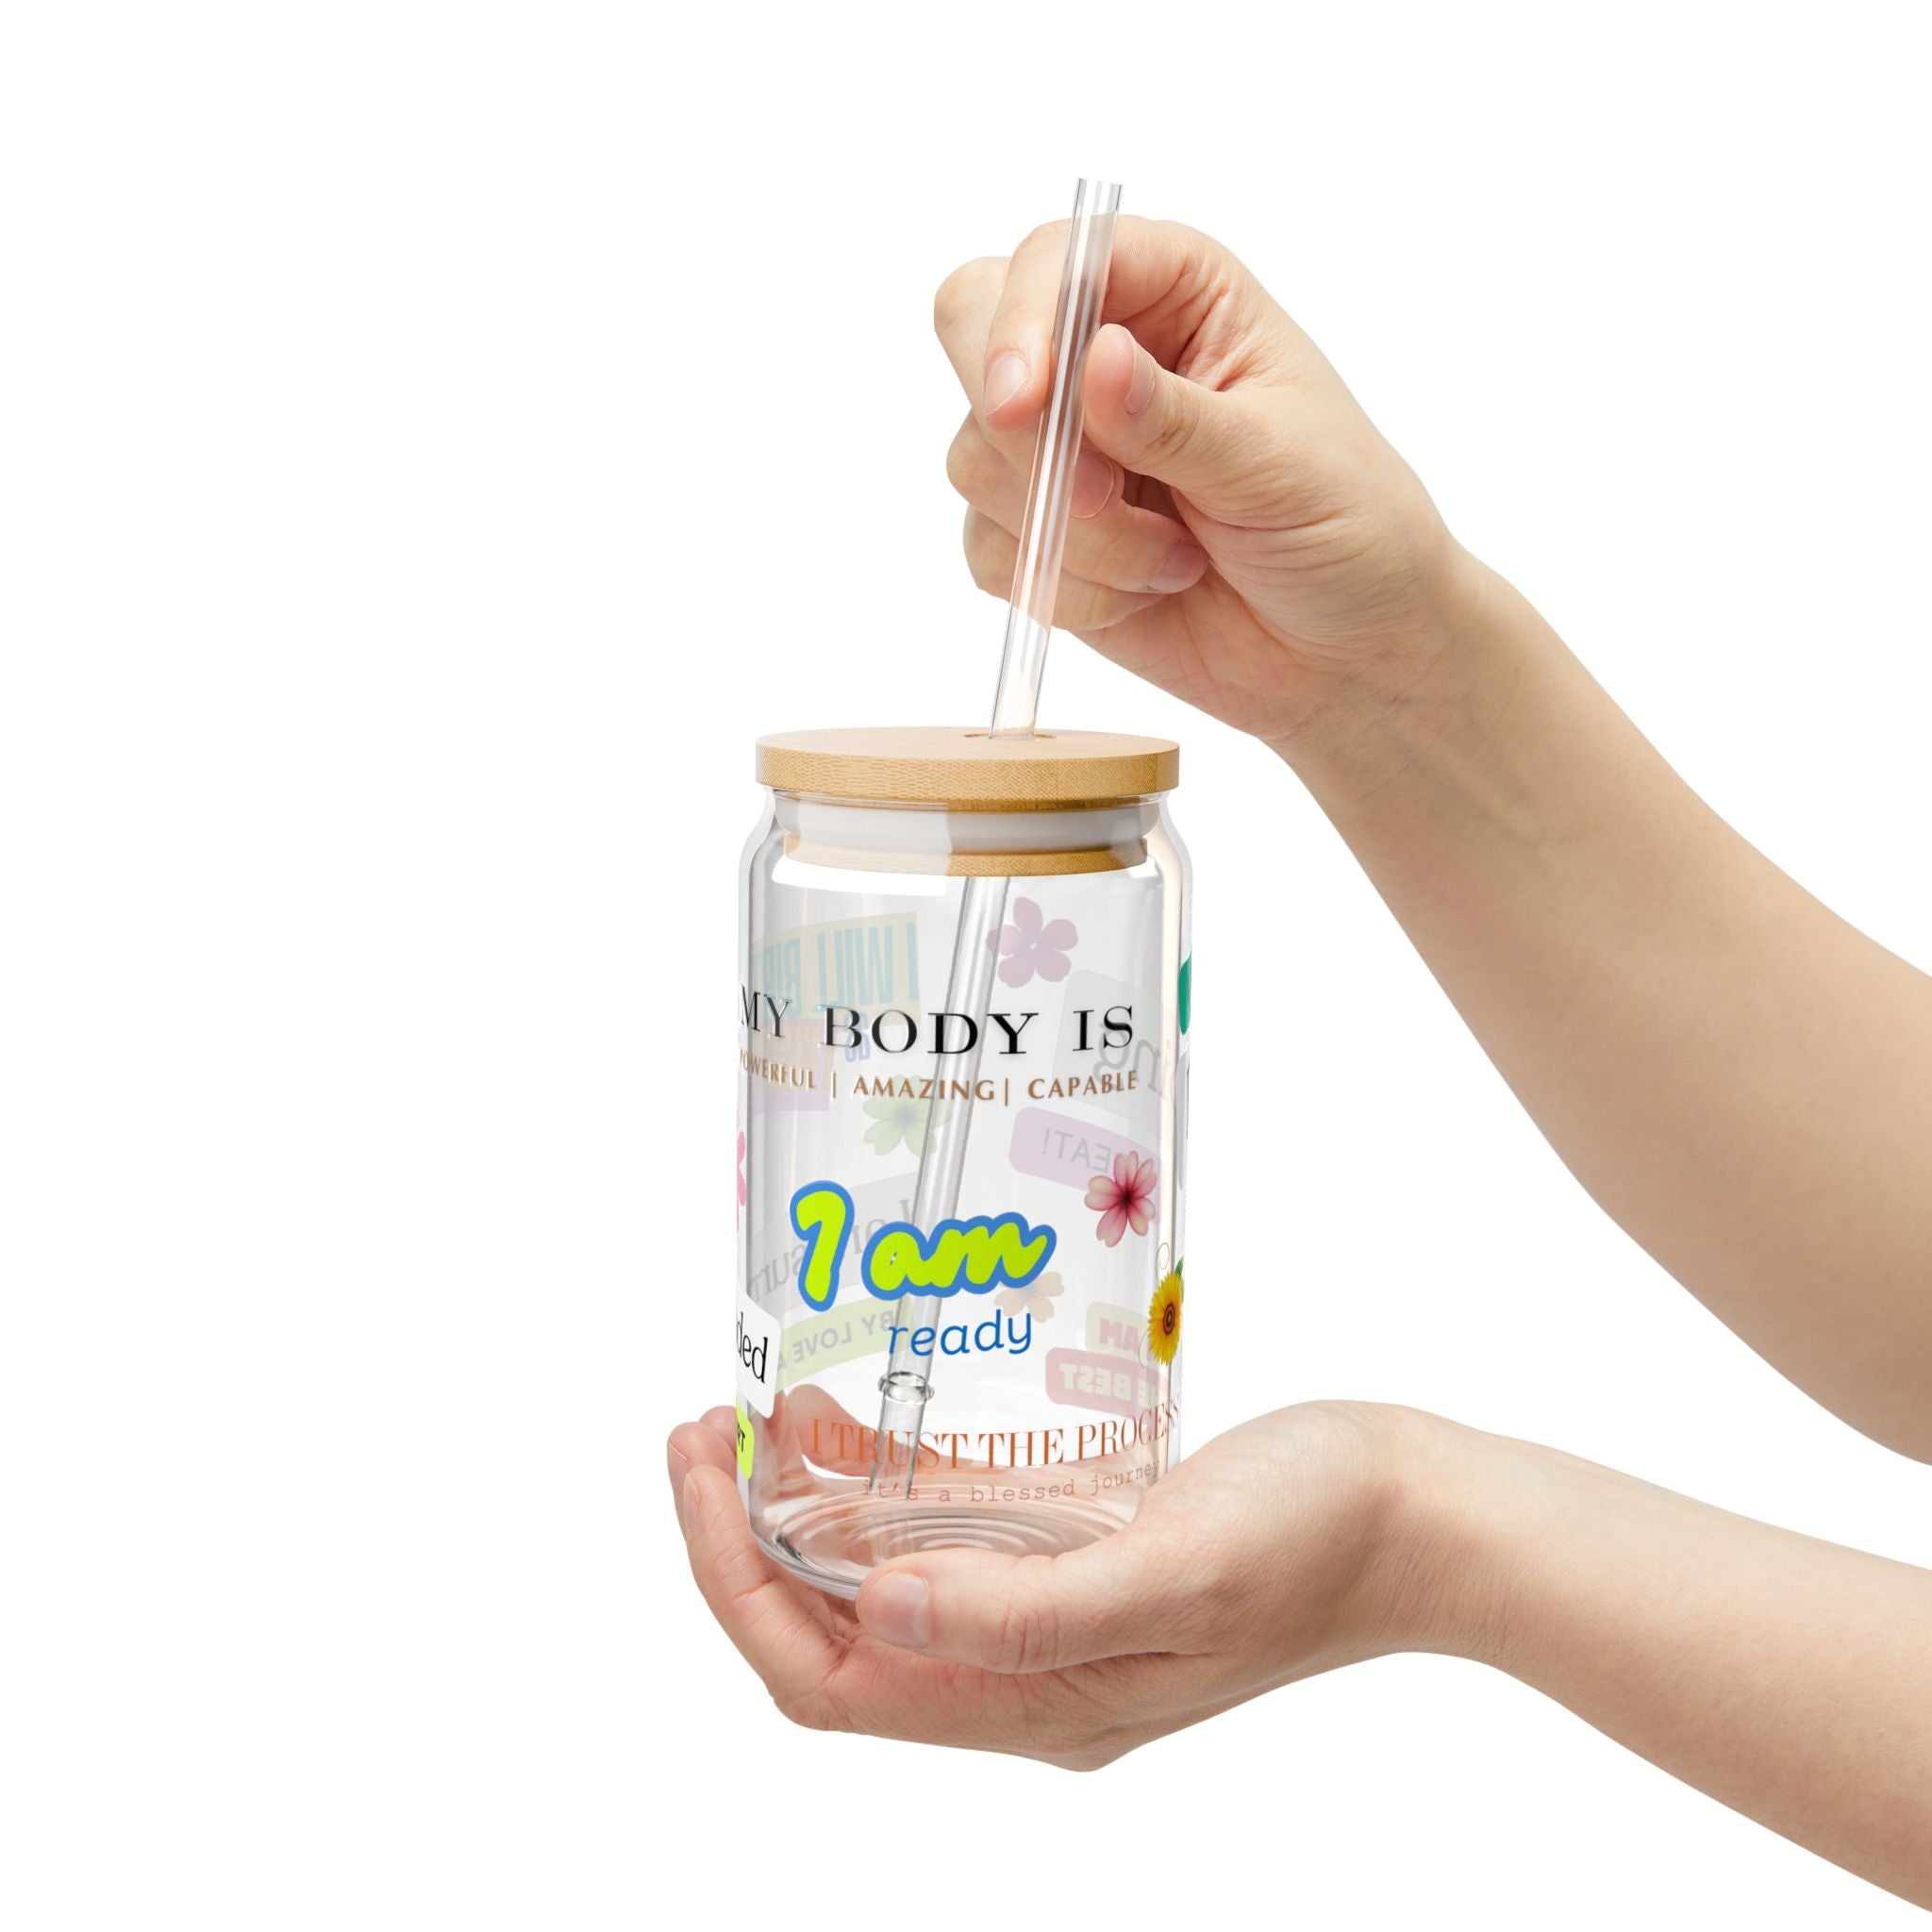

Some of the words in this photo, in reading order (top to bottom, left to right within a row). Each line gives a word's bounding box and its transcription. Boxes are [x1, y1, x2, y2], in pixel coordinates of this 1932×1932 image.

[740, 983, 793, 1039] MY
[817, 1005, 1040, 1054] BODY
[1072, 1005, 1133, 1052] IS
[739, 1048, 818, 1090] POWERFUL
[1027, 1070, 1138, 1100] CAPABLE
[860, 1211, 1058, 1302] am
[888, 1308, 1033, 1356] ready
[809, 1417, 824, 1456] I
[830, 1422, 970, 1470] TRUST
[978, 1428, 1064, 1469] THE
[1074, 1391, 1180, 1462] PROCESS
[938, 1488, 952, 1503] a
[970, 1478, 1075, 1503] blessed
[1090, 1459, 1160, 1497] journey
